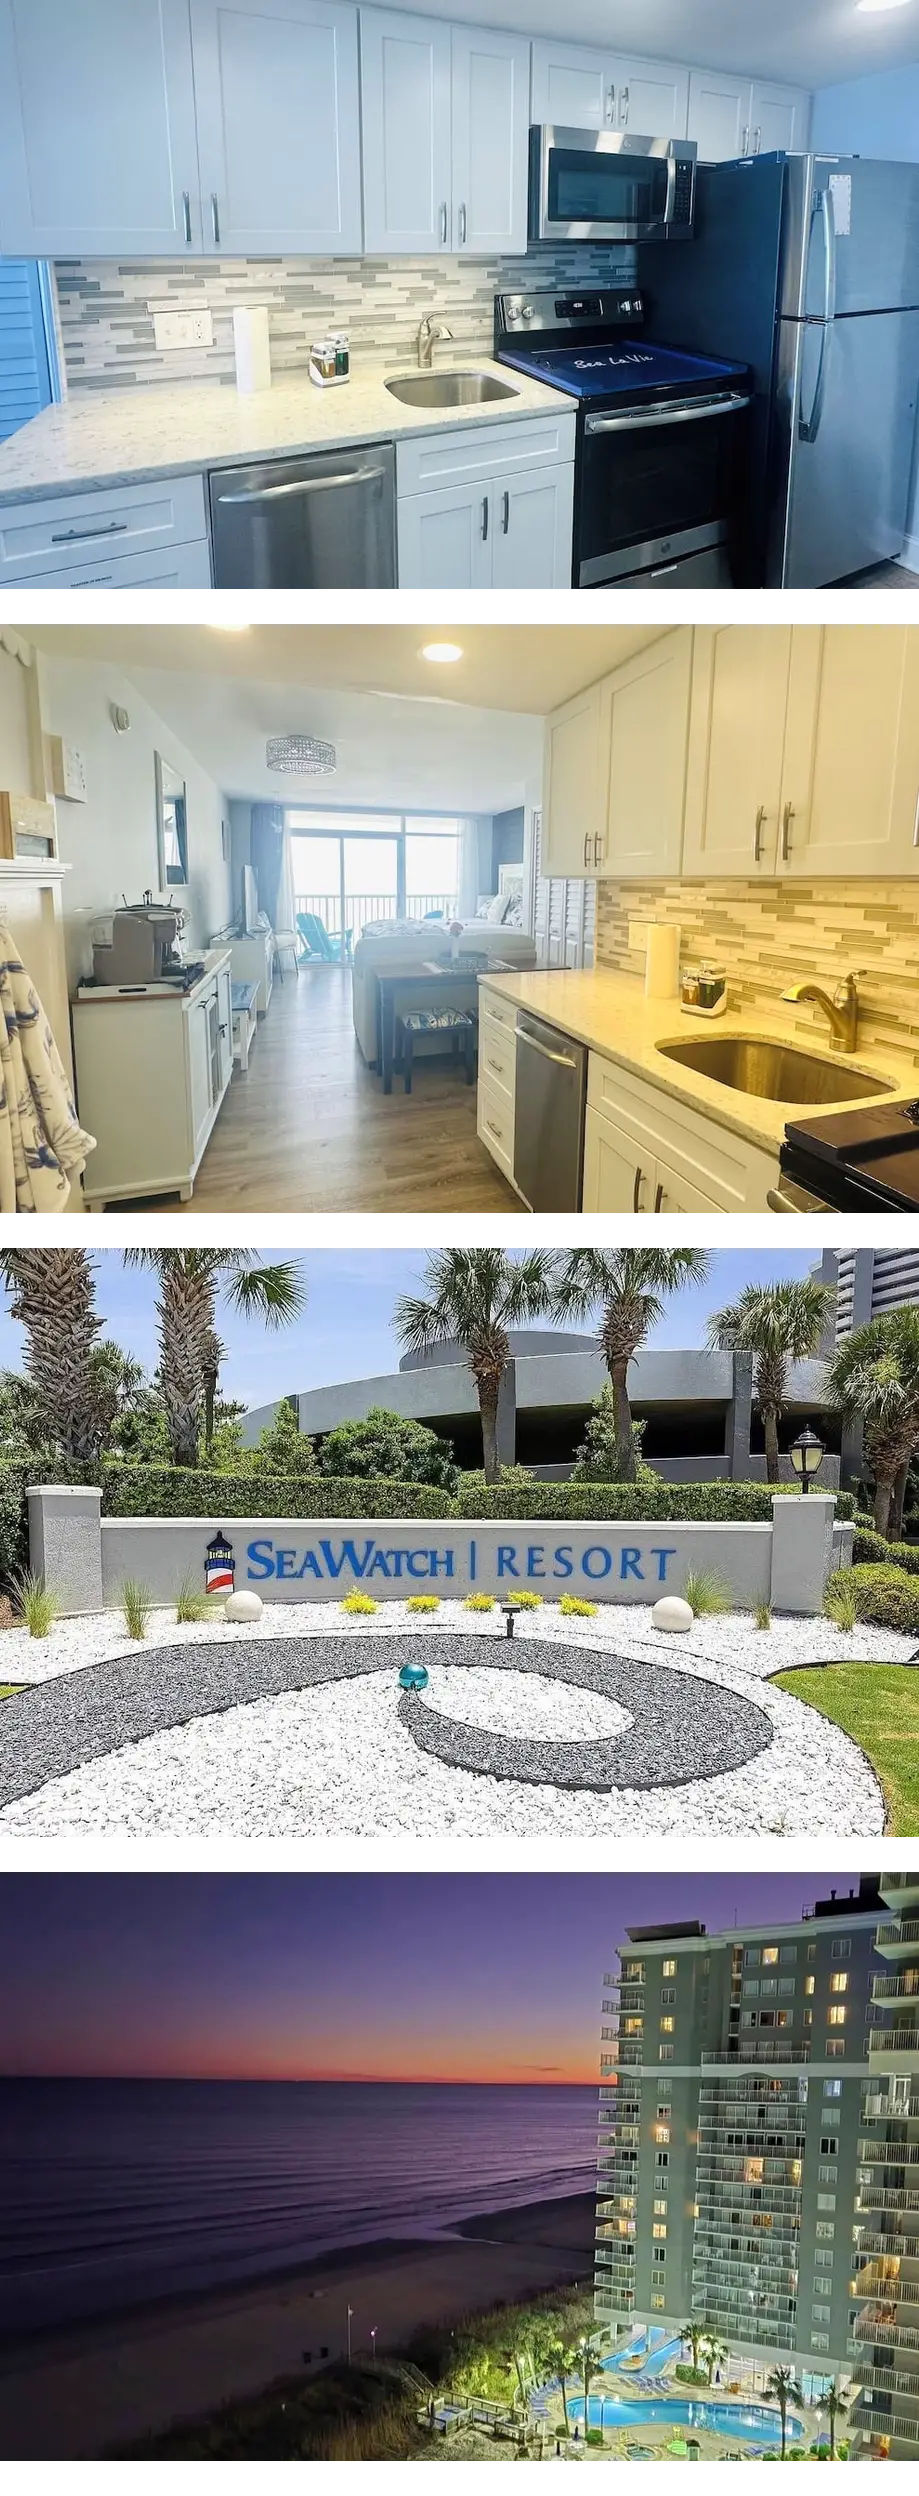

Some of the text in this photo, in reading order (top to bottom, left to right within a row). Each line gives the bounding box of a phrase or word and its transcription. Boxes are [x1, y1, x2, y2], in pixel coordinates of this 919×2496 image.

[574, 360, 606, 369] Sea
[246, 1540, 677, 1581] SEAWATCH RESORT
